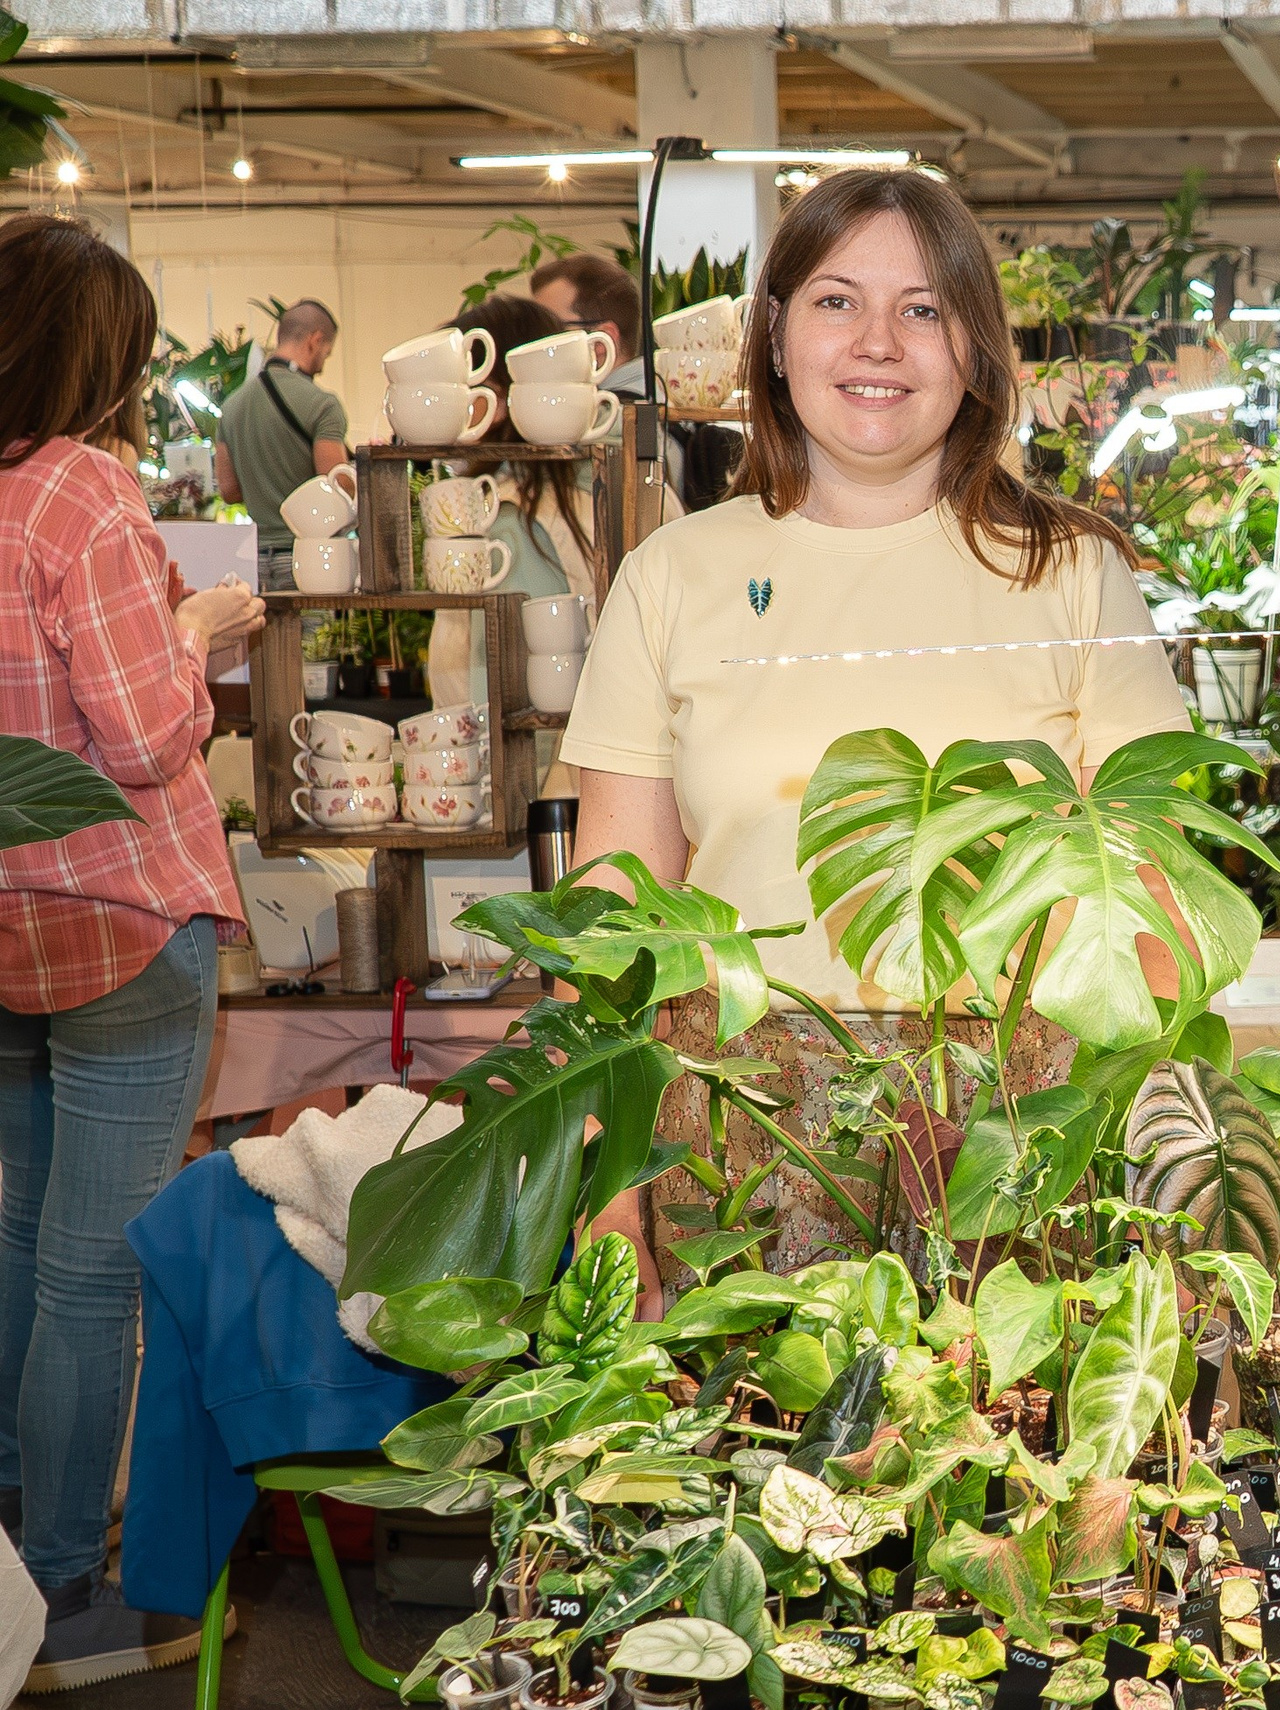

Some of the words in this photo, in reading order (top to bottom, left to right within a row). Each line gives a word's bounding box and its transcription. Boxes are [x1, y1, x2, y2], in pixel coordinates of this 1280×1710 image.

[550, 1598, 581, 1617] 700
[1184, 1600, 1214, 1617] 500
[1010, 1650, 1048, 1669] 1000
